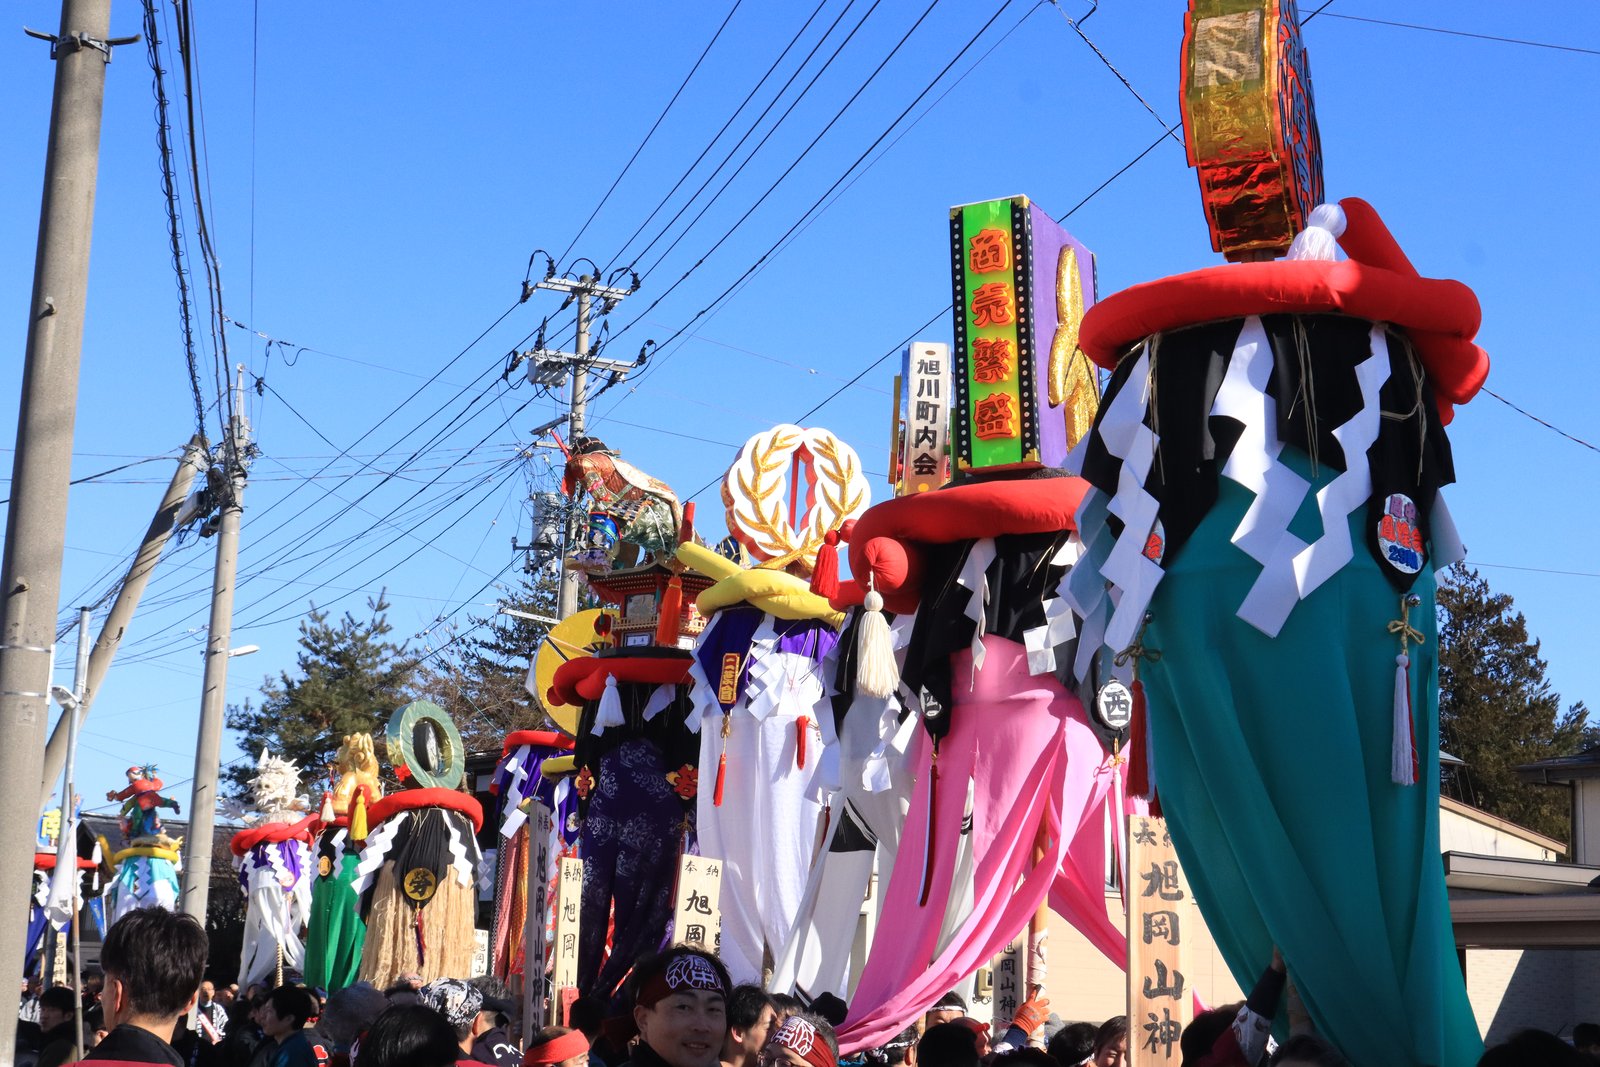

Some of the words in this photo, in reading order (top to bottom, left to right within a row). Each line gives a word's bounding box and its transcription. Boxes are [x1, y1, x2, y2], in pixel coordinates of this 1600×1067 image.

[913, 359, 941, 475] 旭川町内会
[1103, 689, 1131, 721] 西
[685, 860, 719, 878] 奉納
[1140, 860, 1185, 1060] 旭岡山神
